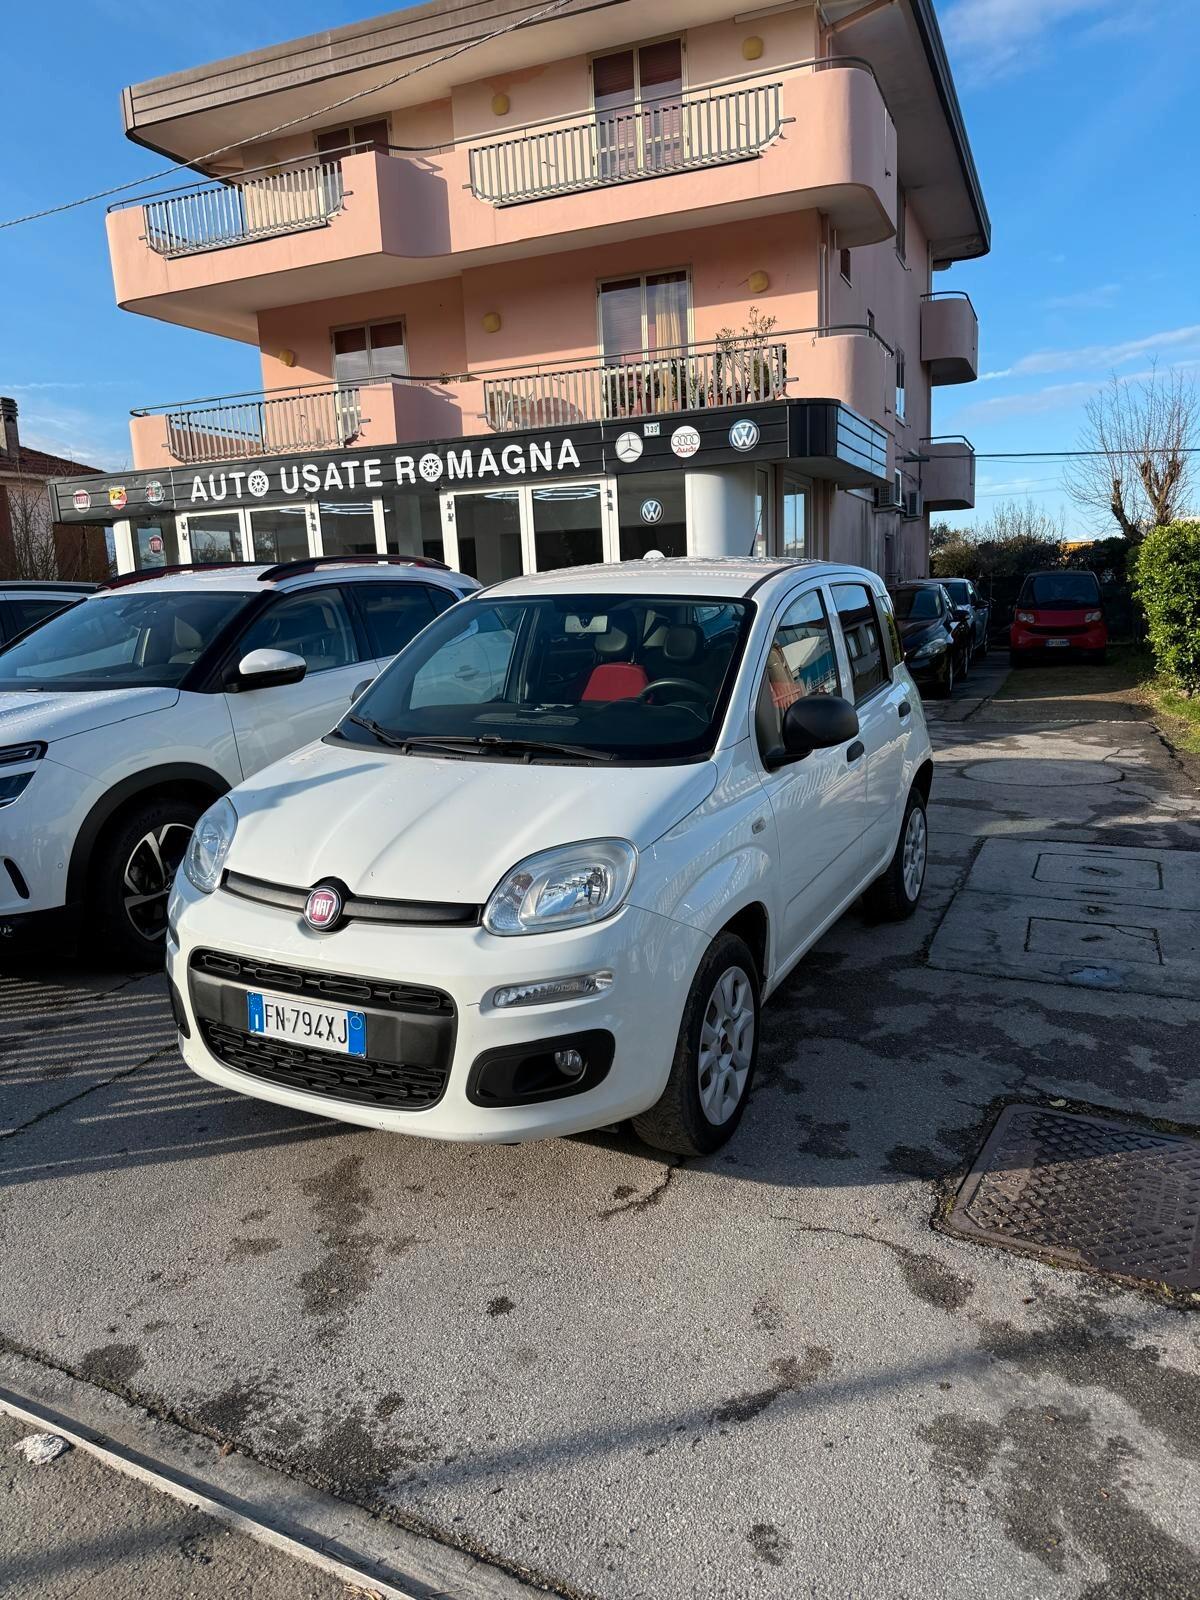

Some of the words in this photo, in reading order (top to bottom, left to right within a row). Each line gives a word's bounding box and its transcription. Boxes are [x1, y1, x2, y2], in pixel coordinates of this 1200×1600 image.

[676, 446, 697, 454] Audi
[190, 468, 270, 503] AUTO
[280, 458, 385, 495] USATE
[395, 438, 581, 486] ROMAGNA
[312, 898, 333, 917] FIAT
